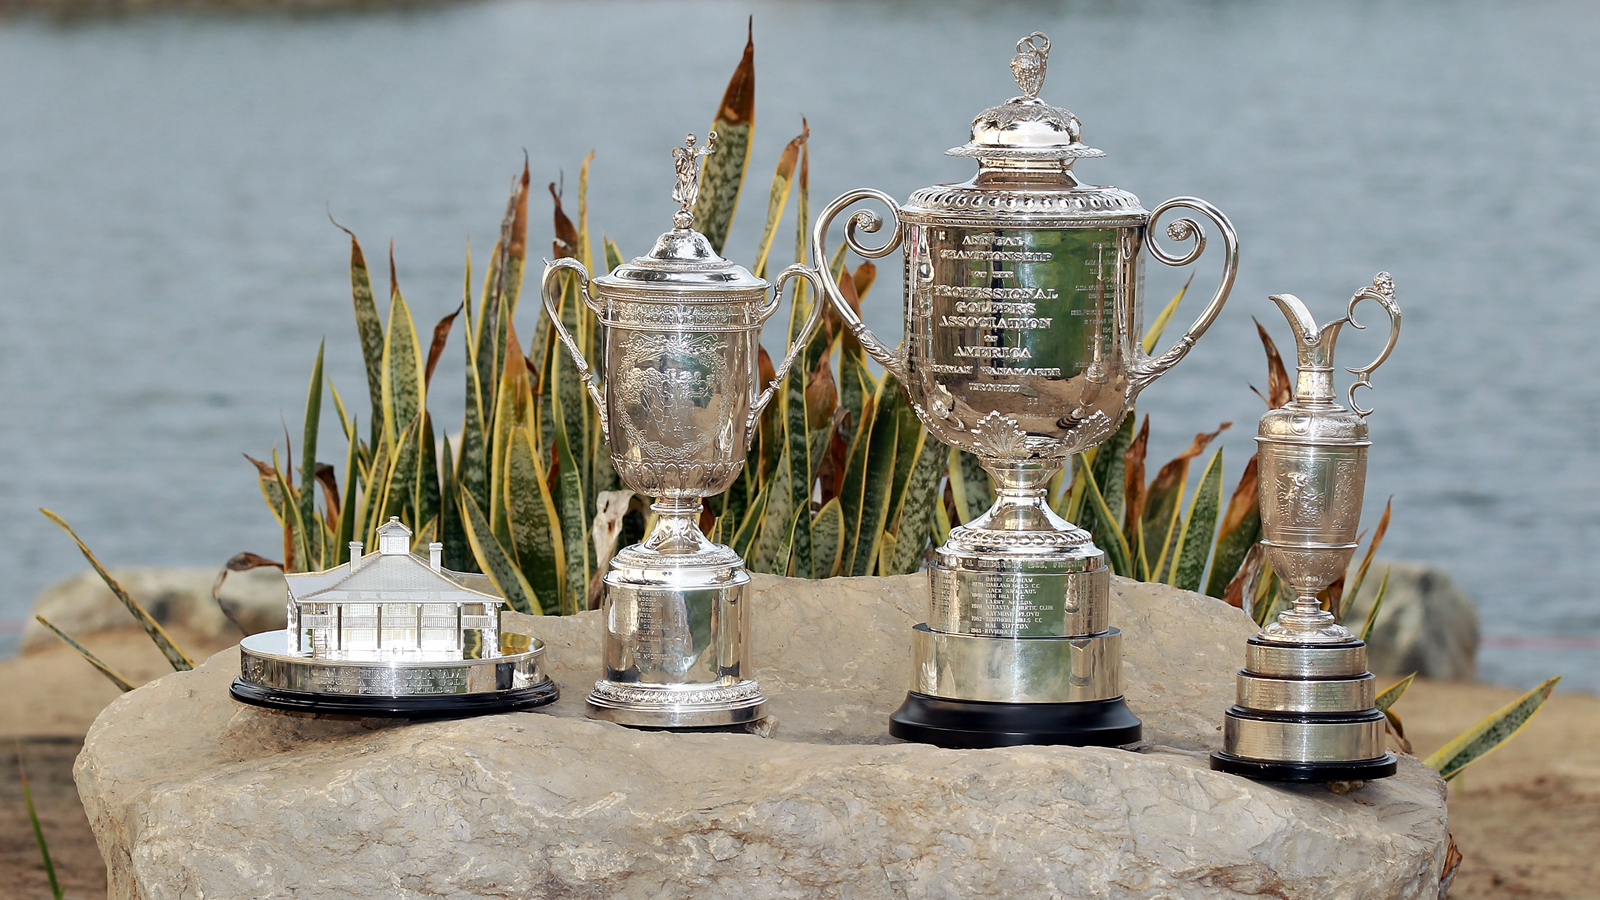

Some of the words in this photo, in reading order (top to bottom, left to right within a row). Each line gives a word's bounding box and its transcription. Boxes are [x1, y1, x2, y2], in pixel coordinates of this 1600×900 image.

[940, 249, 1053, 262] CHAMPIONSHIP
[933, 284, 1059, 300] PROFESSIONAL
[955, 301, 1037, 314] GOLFERS
[939, 315, 1053, 329] ASSOCIATION
[953, 346, 1033, 359] AMERICA
[979, 366, 1061, 377] WANAMAKER
